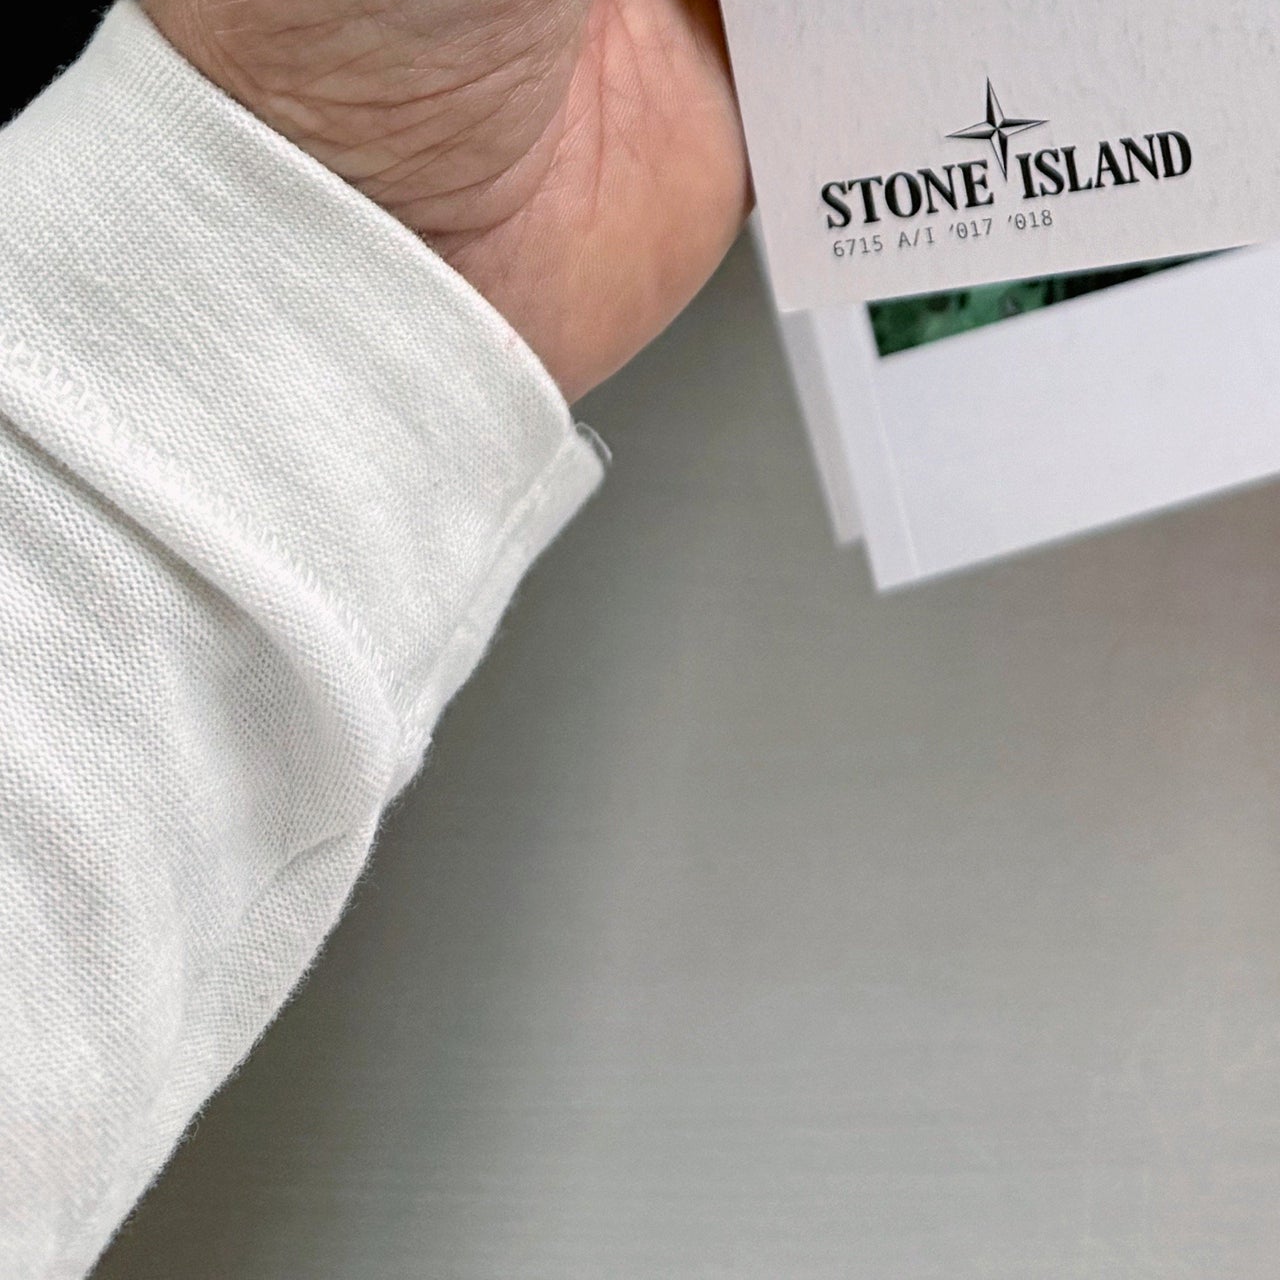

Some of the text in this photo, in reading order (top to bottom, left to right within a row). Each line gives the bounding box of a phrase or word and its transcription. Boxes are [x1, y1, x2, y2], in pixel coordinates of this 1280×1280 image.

[821, 130, 1193, 230] STONE ISLAND
[833, 209, 1054, 258] 6715 A/I '017 '018
